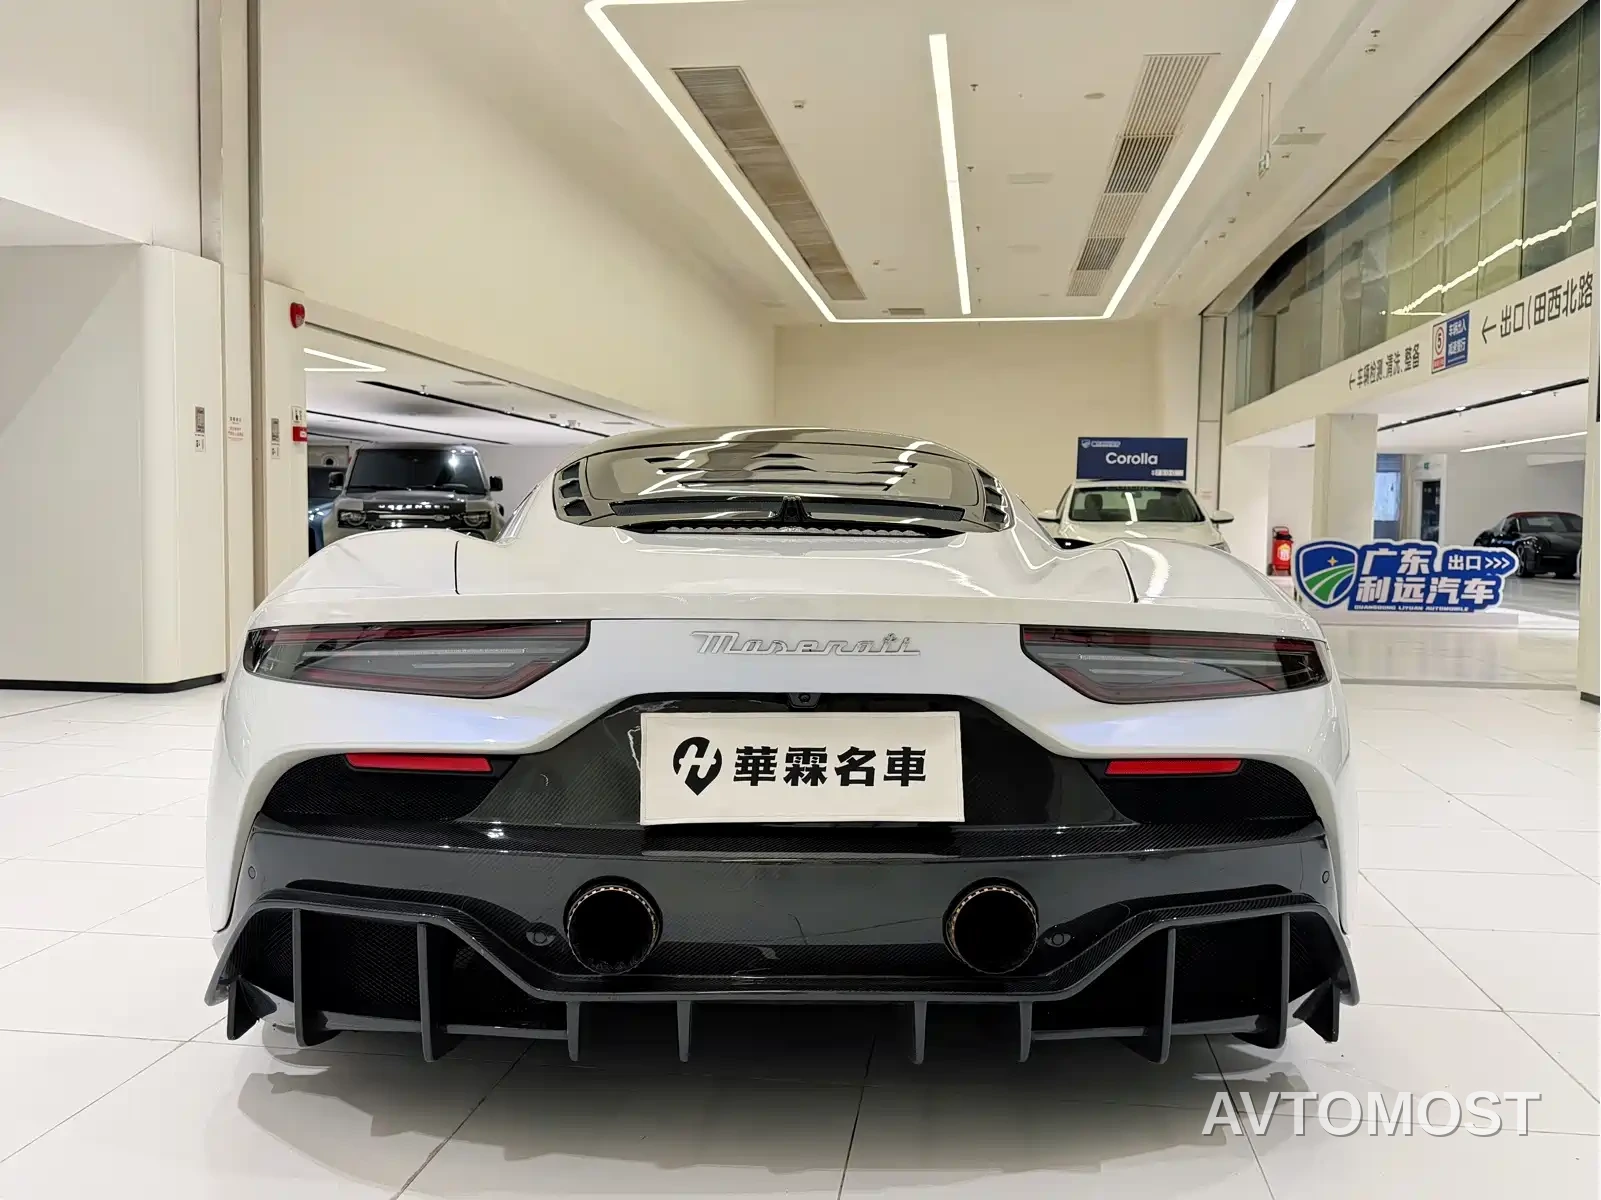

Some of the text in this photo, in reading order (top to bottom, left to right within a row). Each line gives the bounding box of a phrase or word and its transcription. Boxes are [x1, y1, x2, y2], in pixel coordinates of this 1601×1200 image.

[1105, 452, 1158, 465] Corolla
[1361, 548, 1432, 576] 广东
[1448, 555, 1481, 571] 出口
[1356, 576, 1496, 604] 利远汽车
[690, 631, 921, 656] Maserati
[733, 746, 926, 787] 華霖名車
